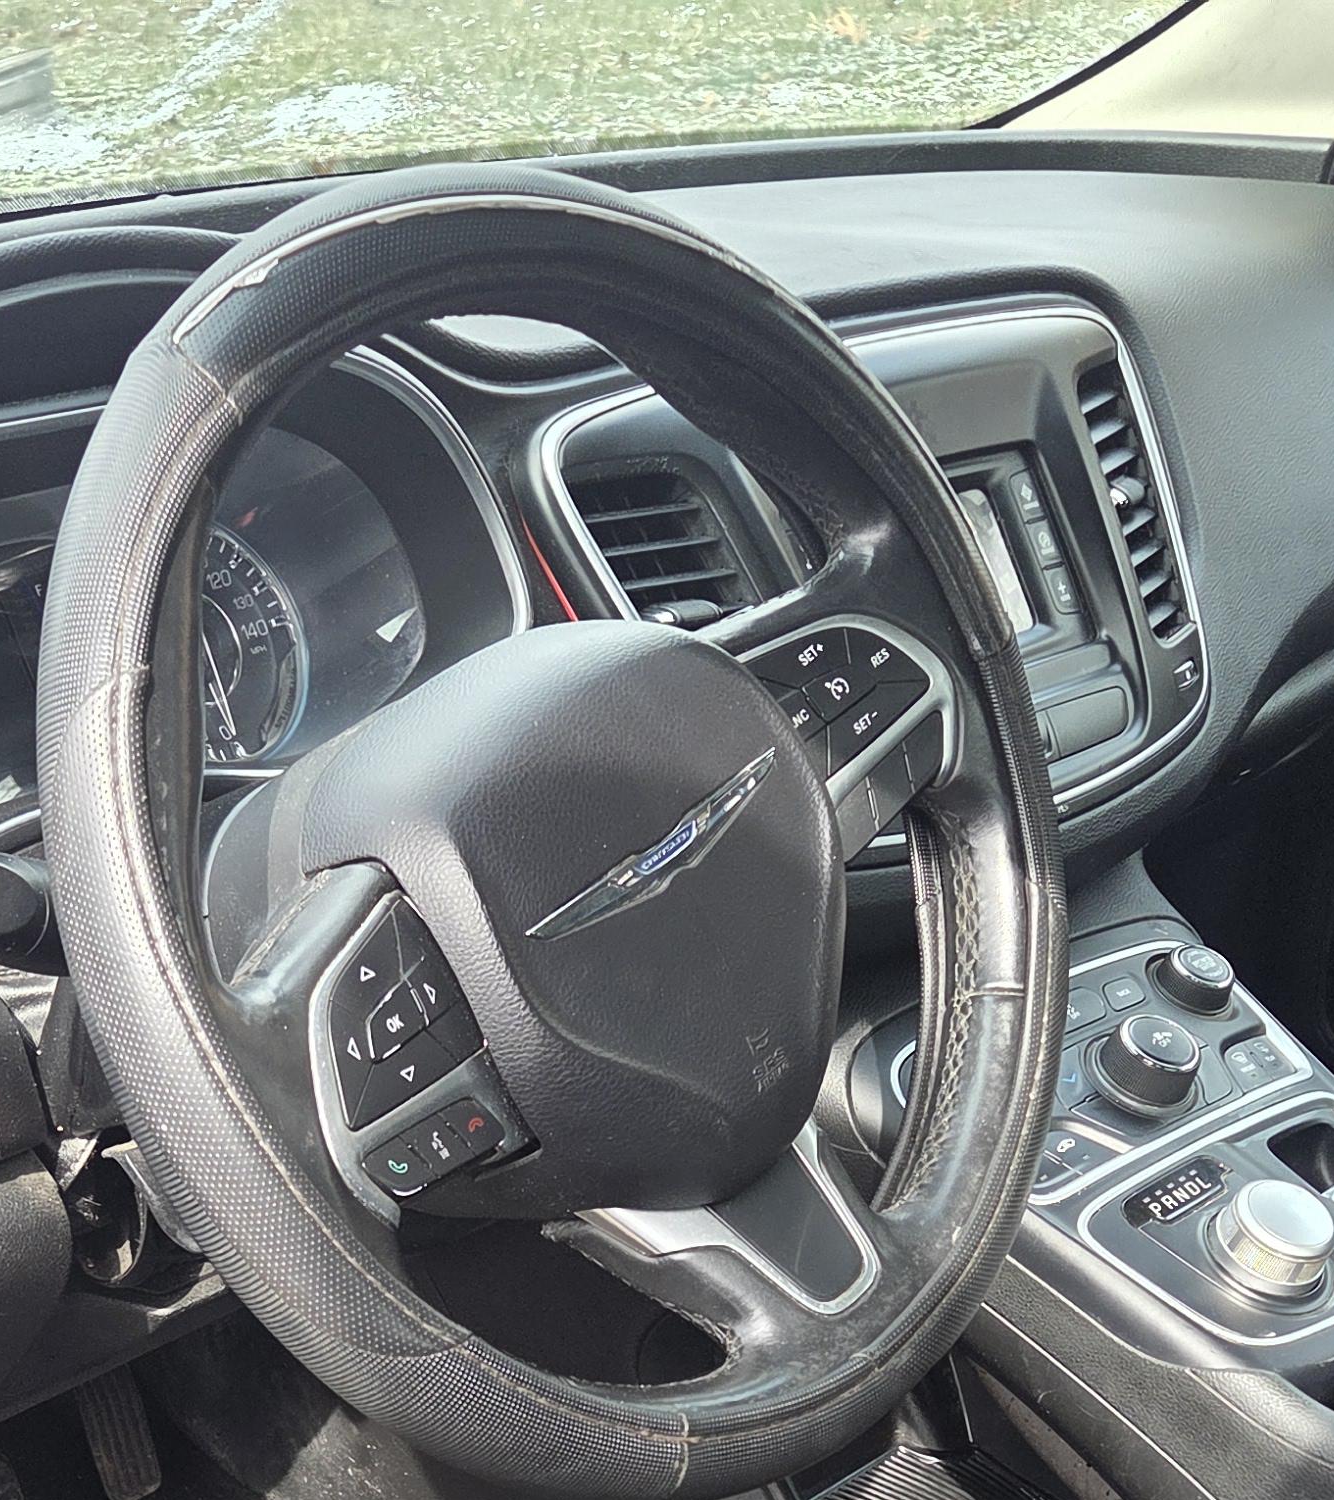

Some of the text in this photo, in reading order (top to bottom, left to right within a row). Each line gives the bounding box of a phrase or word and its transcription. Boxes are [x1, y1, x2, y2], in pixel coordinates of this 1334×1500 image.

[206, 569, 232, 590] 120
[34, 583, 43, 598] F
[233, 593, 255, 610] 130
[241, 618, 269, 641] 140
[870, 647, 891, 668] RES
[385, 1013, 405, 1033] OK
